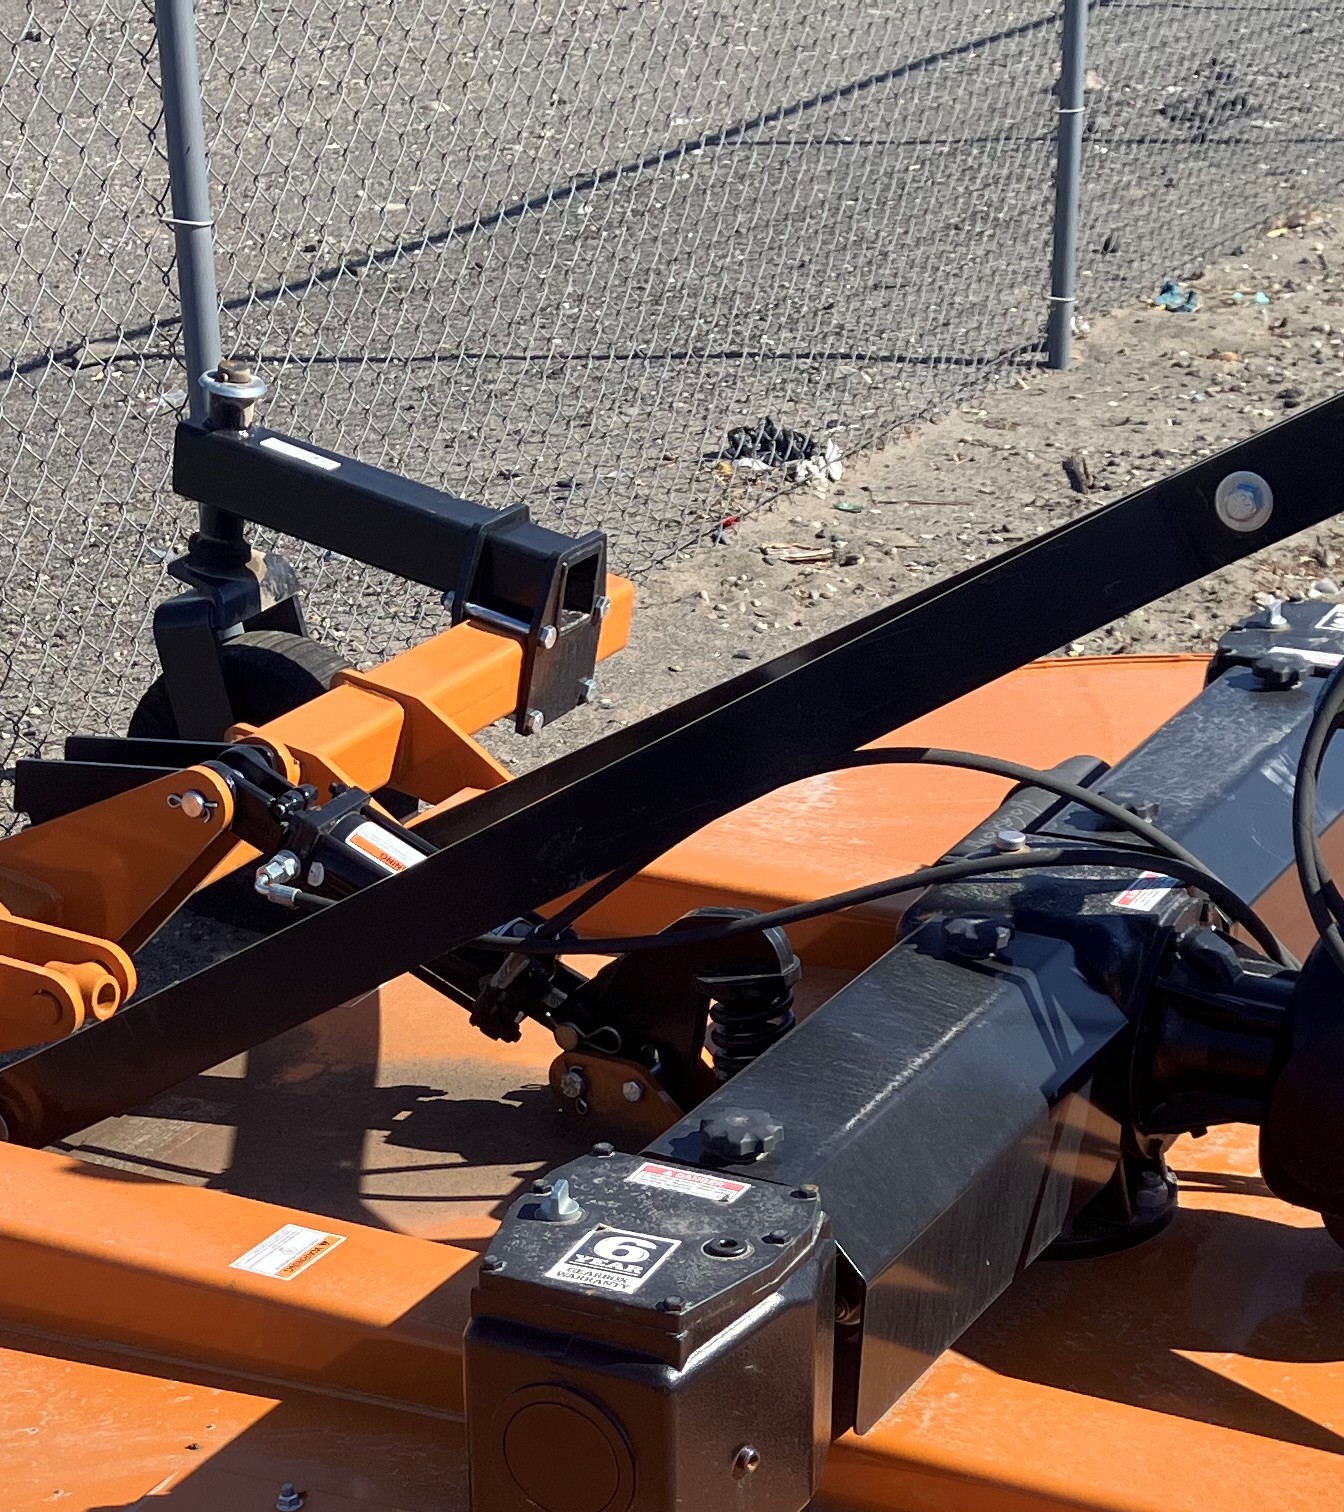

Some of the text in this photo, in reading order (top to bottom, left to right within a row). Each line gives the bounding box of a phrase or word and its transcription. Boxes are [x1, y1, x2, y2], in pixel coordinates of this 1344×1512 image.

[594, 1236, 656, 1264] 6
[566, 1267, 630, 1284] GEARBOX
[576, 1253, 644, 1276] YEAR
[555, 1270, 631, 1291] WARRANTY
